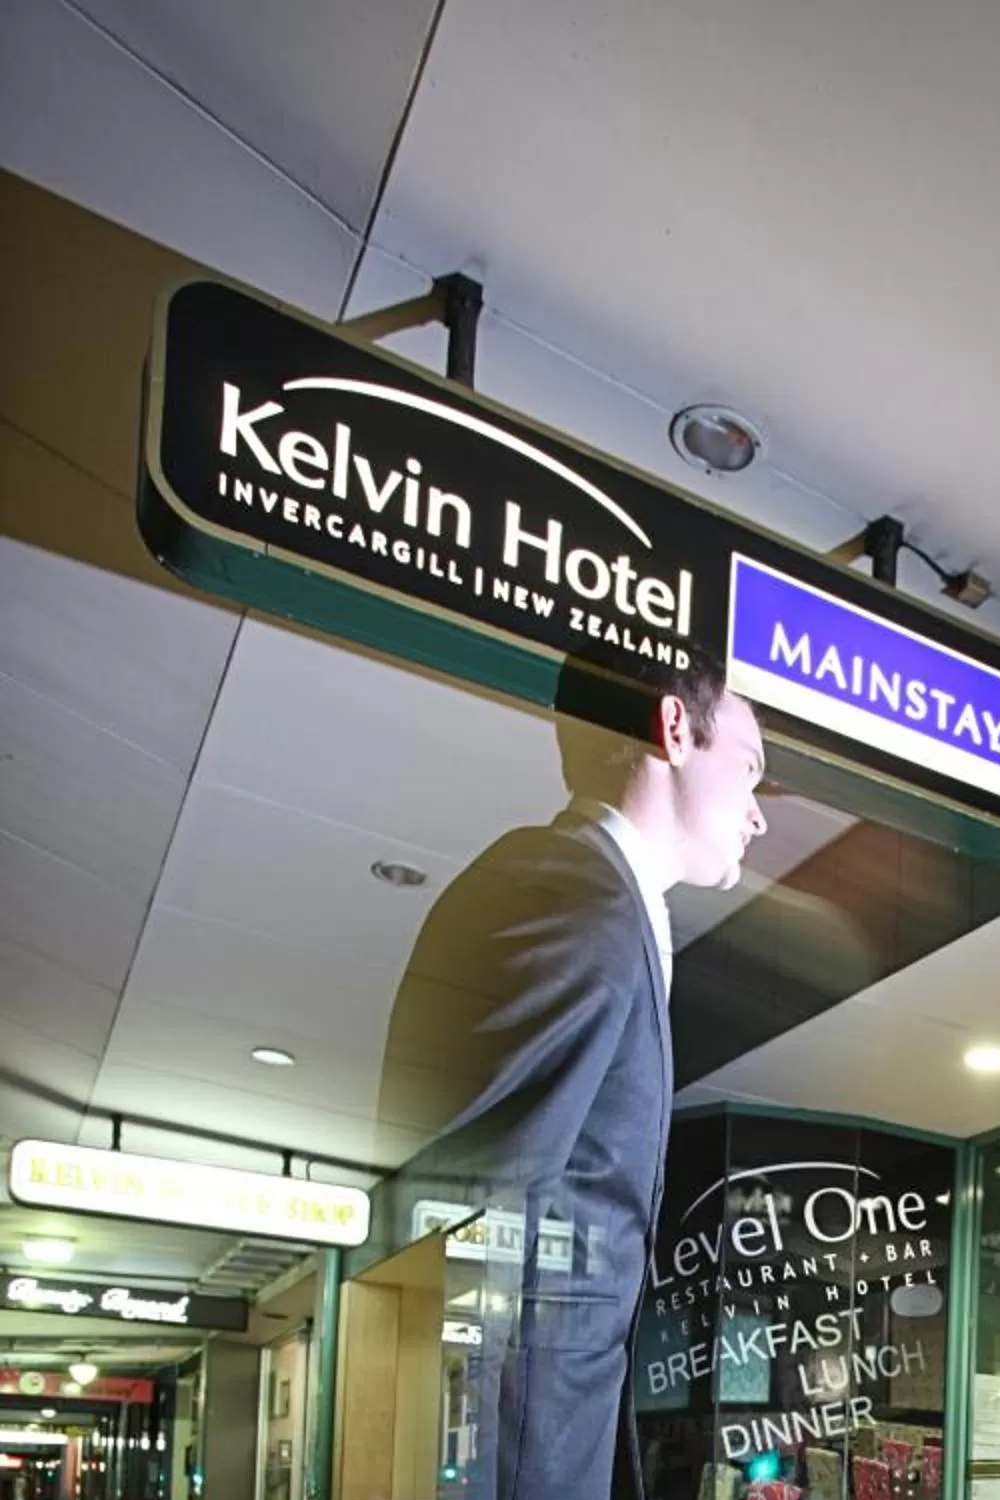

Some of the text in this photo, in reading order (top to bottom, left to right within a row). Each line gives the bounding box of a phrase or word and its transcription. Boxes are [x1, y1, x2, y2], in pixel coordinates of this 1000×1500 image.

[219, 381, 693, 637] Kelvin Hotel
[217, 472, 464, 585] INVERCARGILL
[493, 577, 555, 618] NEW
[569, 607, 691, 670] ZEALAND
[650, 1193, 784, 1289] Level
[803, 1186, 928, 1243] One
[655, 1252, 839, 1316] RESTAURANT
[885, 1238, 933, 1263] BAR
[659, 1269, 937, 1344] KELVIN HOTEL
[646, 1307, 865, 1395] BREAKFAST
[799, 1339, 926, 1397] LUNCH
[720, 1395, 878, 1459] DINNER
